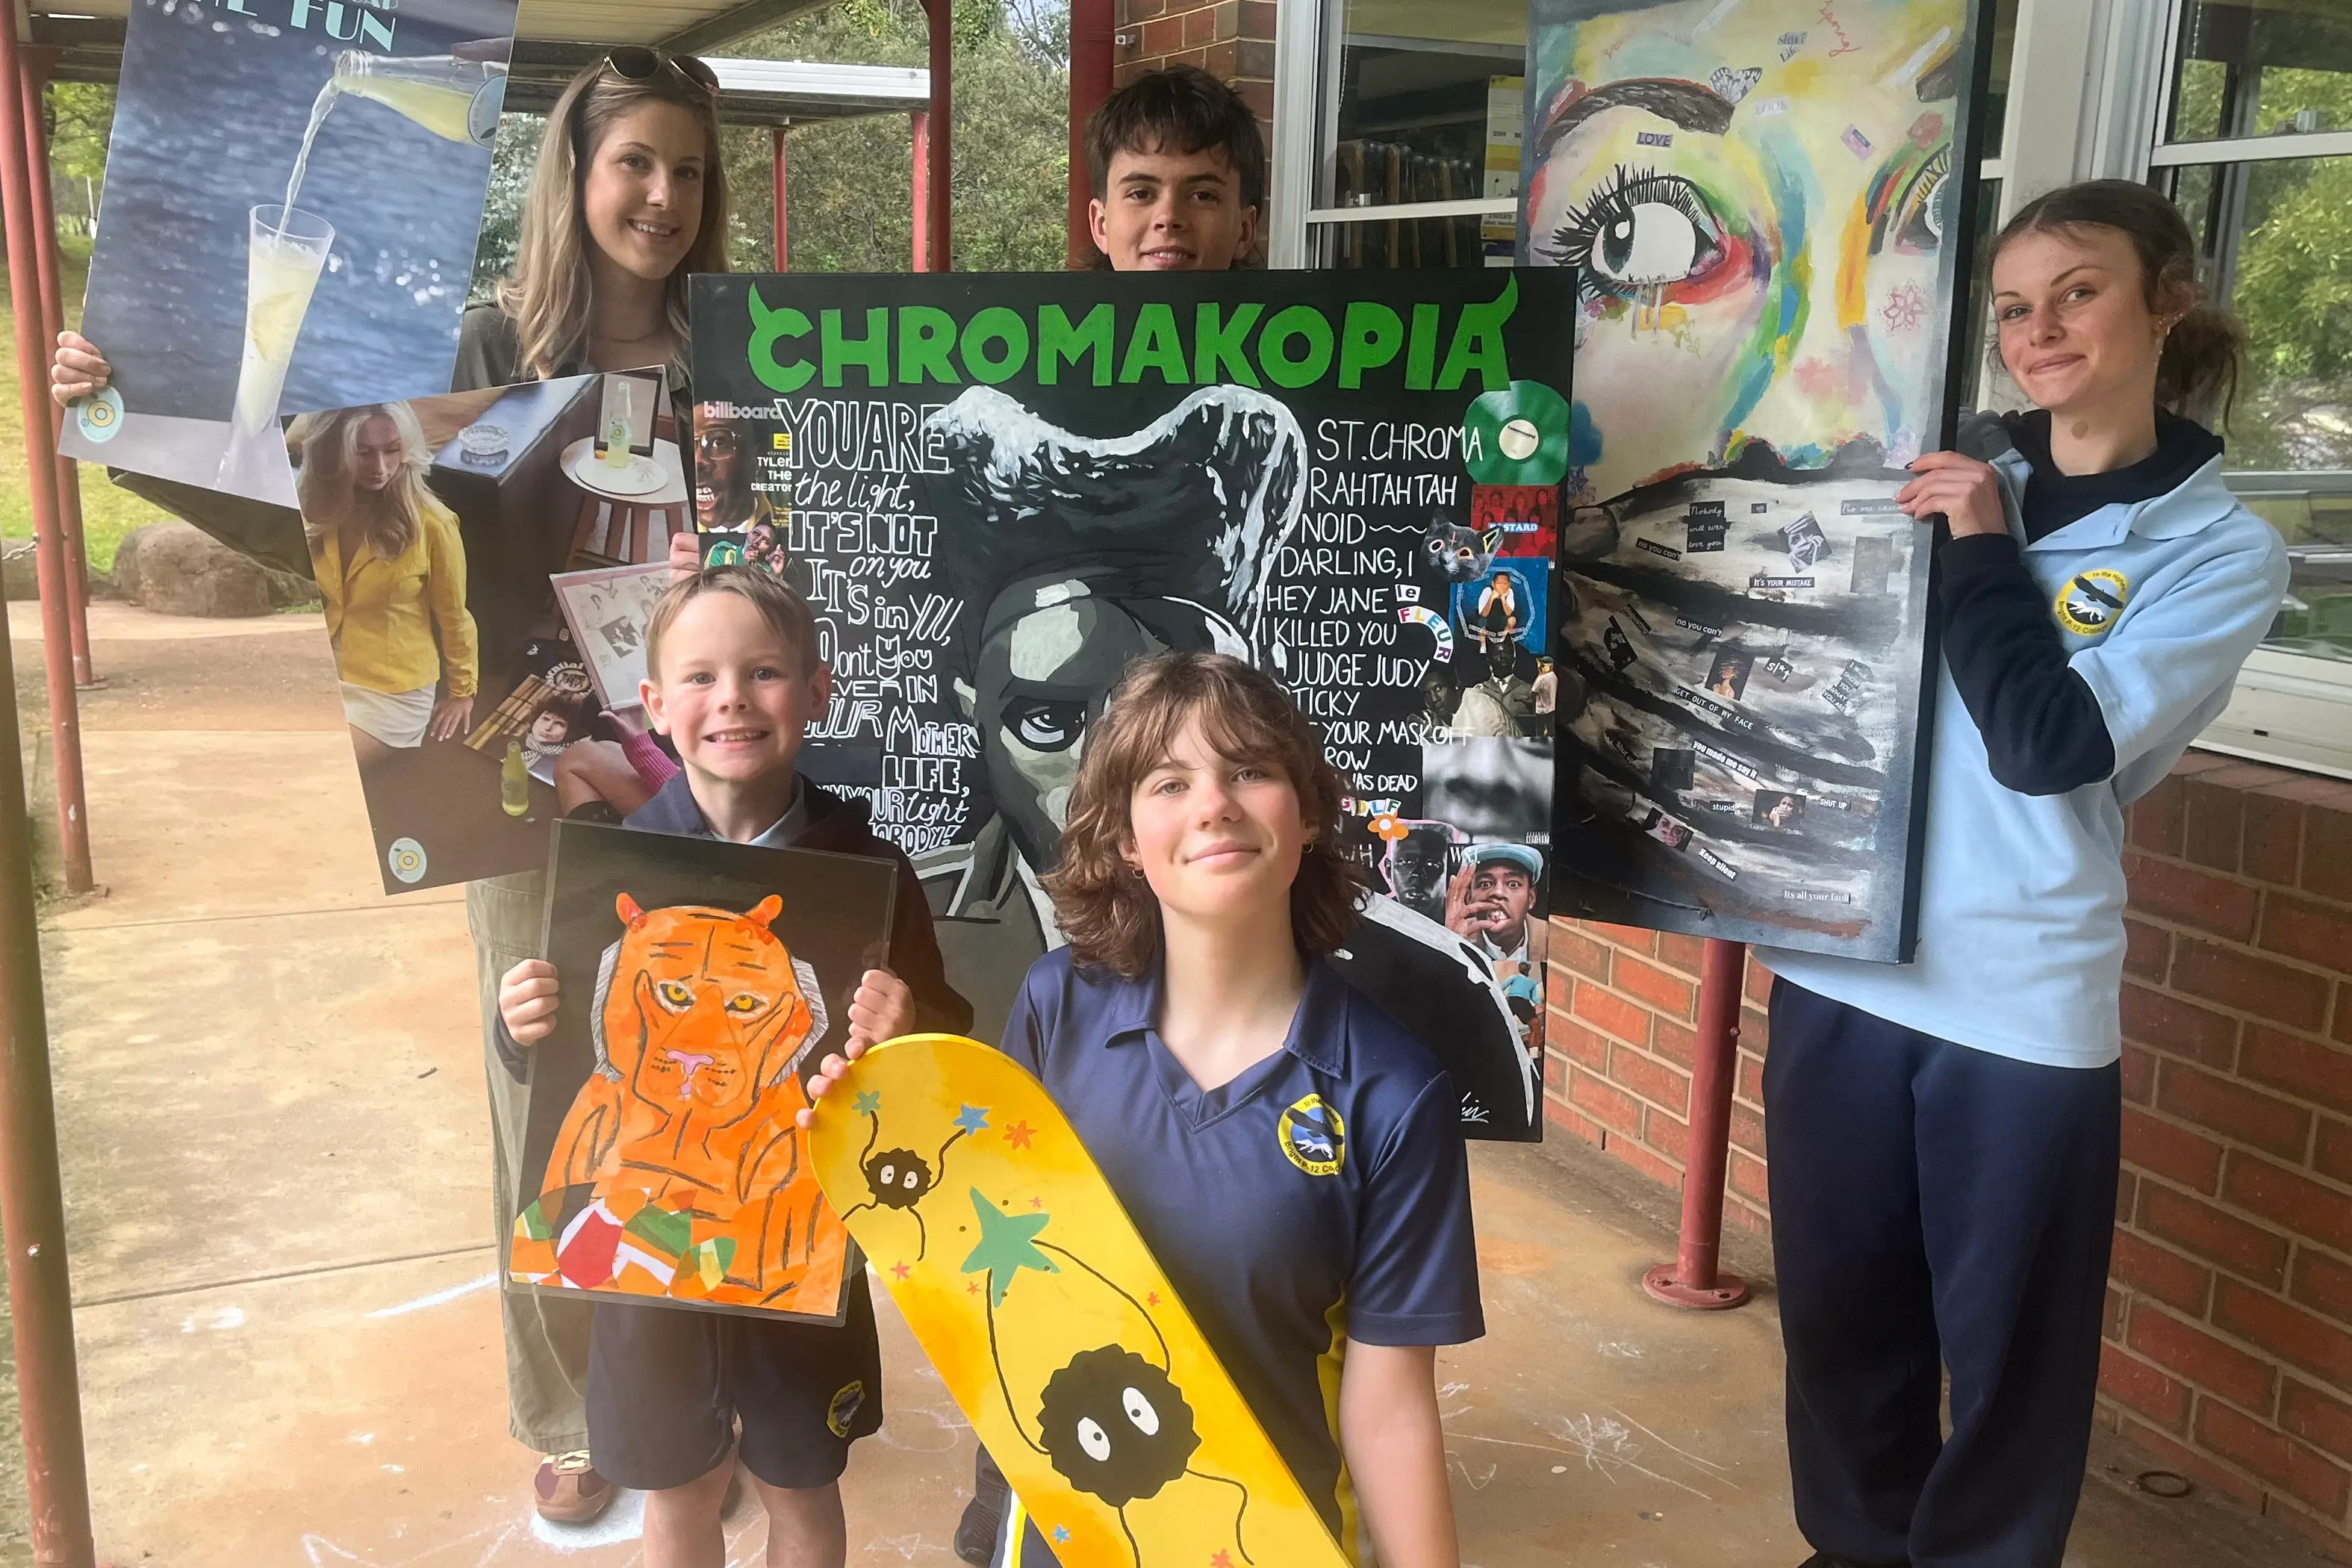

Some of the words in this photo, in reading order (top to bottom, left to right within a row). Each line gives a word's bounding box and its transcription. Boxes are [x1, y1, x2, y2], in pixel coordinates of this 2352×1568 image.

[290, 0, 396, 52] FUN
[1637, 133, 1672, 147] LOVE
[748, 277, 1518, 393] CHROMAKOPIA
[794, 470, 842, 507] the
[847, 473, 915, 513] light,
[1690, 506, 1723, 517] Nobody
[788, 511, 862, 553] IT'S
[866, 513, 938, 557] NOT
[1301, 512, 1366, 545] NOID
[1488, 522, 1538, 532] BSTARD
[1689, 524, 1705, 533] will
[1637, 541, 1648, 550] no
[1648, 544, 1662, 554] you
[1687, 541, 1705, 549] love
[1707, 541, 1723, 550] you
[849, 556, 885, 579] on
[882, 559, 932, 588] you
[1280, 545, 1403, 579] DARLING,
[1407, 550, 1413, 577] I
[1397, 585, 1416, 599] le
[1754, 578, 1765, 587] IT'S
[1767, 579, 1785, 588] YOUR
[1785, 579, 1813, 588] MISTAKE
[874, 596, 909, 629] in
[1266, 585, 1317, 615] HEY
[1319, 588, 1389, 615] JANE
[1623, 606, 1649, 635] disgusting
[1676, 618, 1687, 626] no
[1687, 621, 1702, 630] you
[1702, 626, 1723, 637] can't
[2058, 600, 2068, 621] Bright
[2065, 618, 2081, 632] P-12
[1262, 617, 1266, 646] I
[1274, 617, 1348, 648] KILLED
[1357, 620, 1397, 647] YOU
[1399, 607, 1452, 660] FLEUR
[1287, 649, 1367, 688] JUDGE
[1367, 654, 1431, 688] JUDY
[1843, 671, 1862, 687] SHOW
[831, 679, 903, 700] VER
[906, 673, 938, 704] IN
[1291, 686, 1360, 718] TICKY
[1823, 691, 1835, 703] YOU
[1835, 701, 1847, 713] ARE
[1830, 686, 1847, 703] WHAT
[1839, 681, 1853, 694] YOU
[803, 696, 884, 739] OUR
[1674, 688, 1690, 700] GET
[1691, 695, 1707, 707] OUT
[1708, 703, 1720, 713] OF
[1720, 709, 1733, 719] MY
[1734, 715, 1754, 730] FACE
[1322, 721, 1373, 745] YOUR
[1615, 741, 1629, 759] Shut
[1692, 740, 1707, 754] you
[1705, 747, 1726, 763] made
[1724, 757, 1737, 770] me
[1736, 763, 1752, 777] say
[1749, 768, 1758, 780] it
[882, 755, 970, 798] LIFE,
[1352, 774, 1375, 791] AS
[1378, 774, 1418, 793] DEAD
[904, 791, 970, 827] light
[1712, 803, 1736, 812] stupid
[1819, 798, 1837, 808] SHUT
[1838, 800, 1847, 810] UP
[1698, 847, 1717, 866] Keep
[1715, 861, 1737, 880] silent
[1796, 890, 1807, 900] all
[1808, 892, 1829, 902] your
[1831, 892, 1850, 903] fault
[1284, 1140, 1303, 1165] Bright
